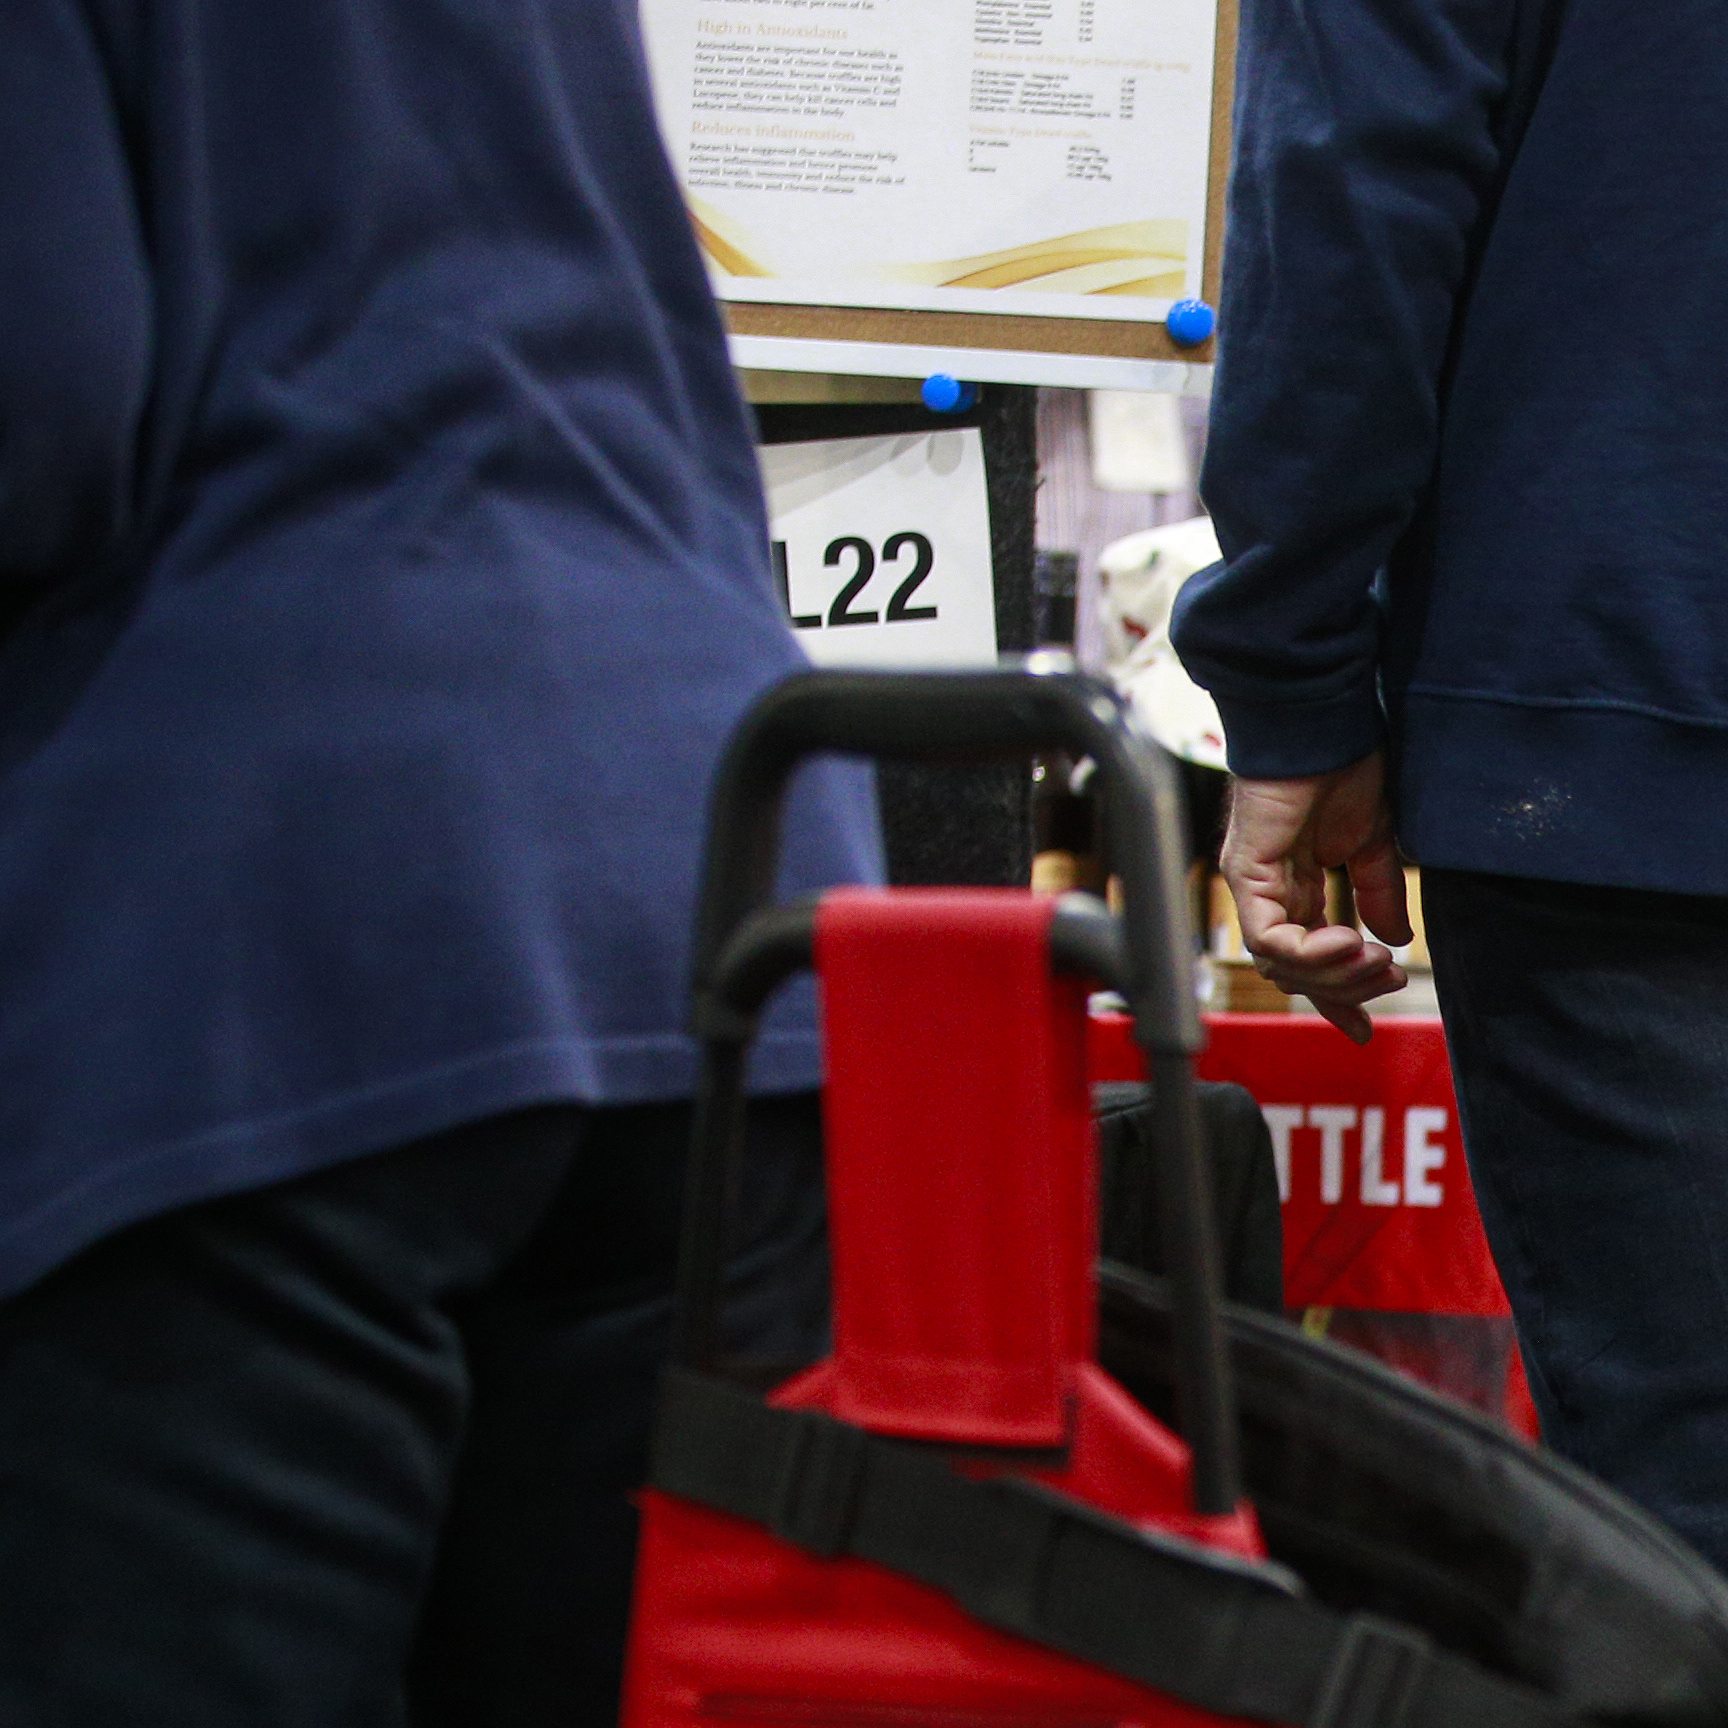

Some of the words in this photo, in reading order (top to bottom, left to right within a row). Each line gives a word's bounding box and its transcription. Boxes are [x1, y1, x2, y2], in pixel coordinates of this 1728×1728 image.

[697, 20, 732, 36] High
[738, 22, 750, 34] in
[758, 23, 847, 39] Antioxidants
[692, 121, 751, 136] Reduces
[755, 124, 855, 141] inflammation
[770, 530, 938, 629] L22
[1260, 1102, 1449, 1208] TTLE
